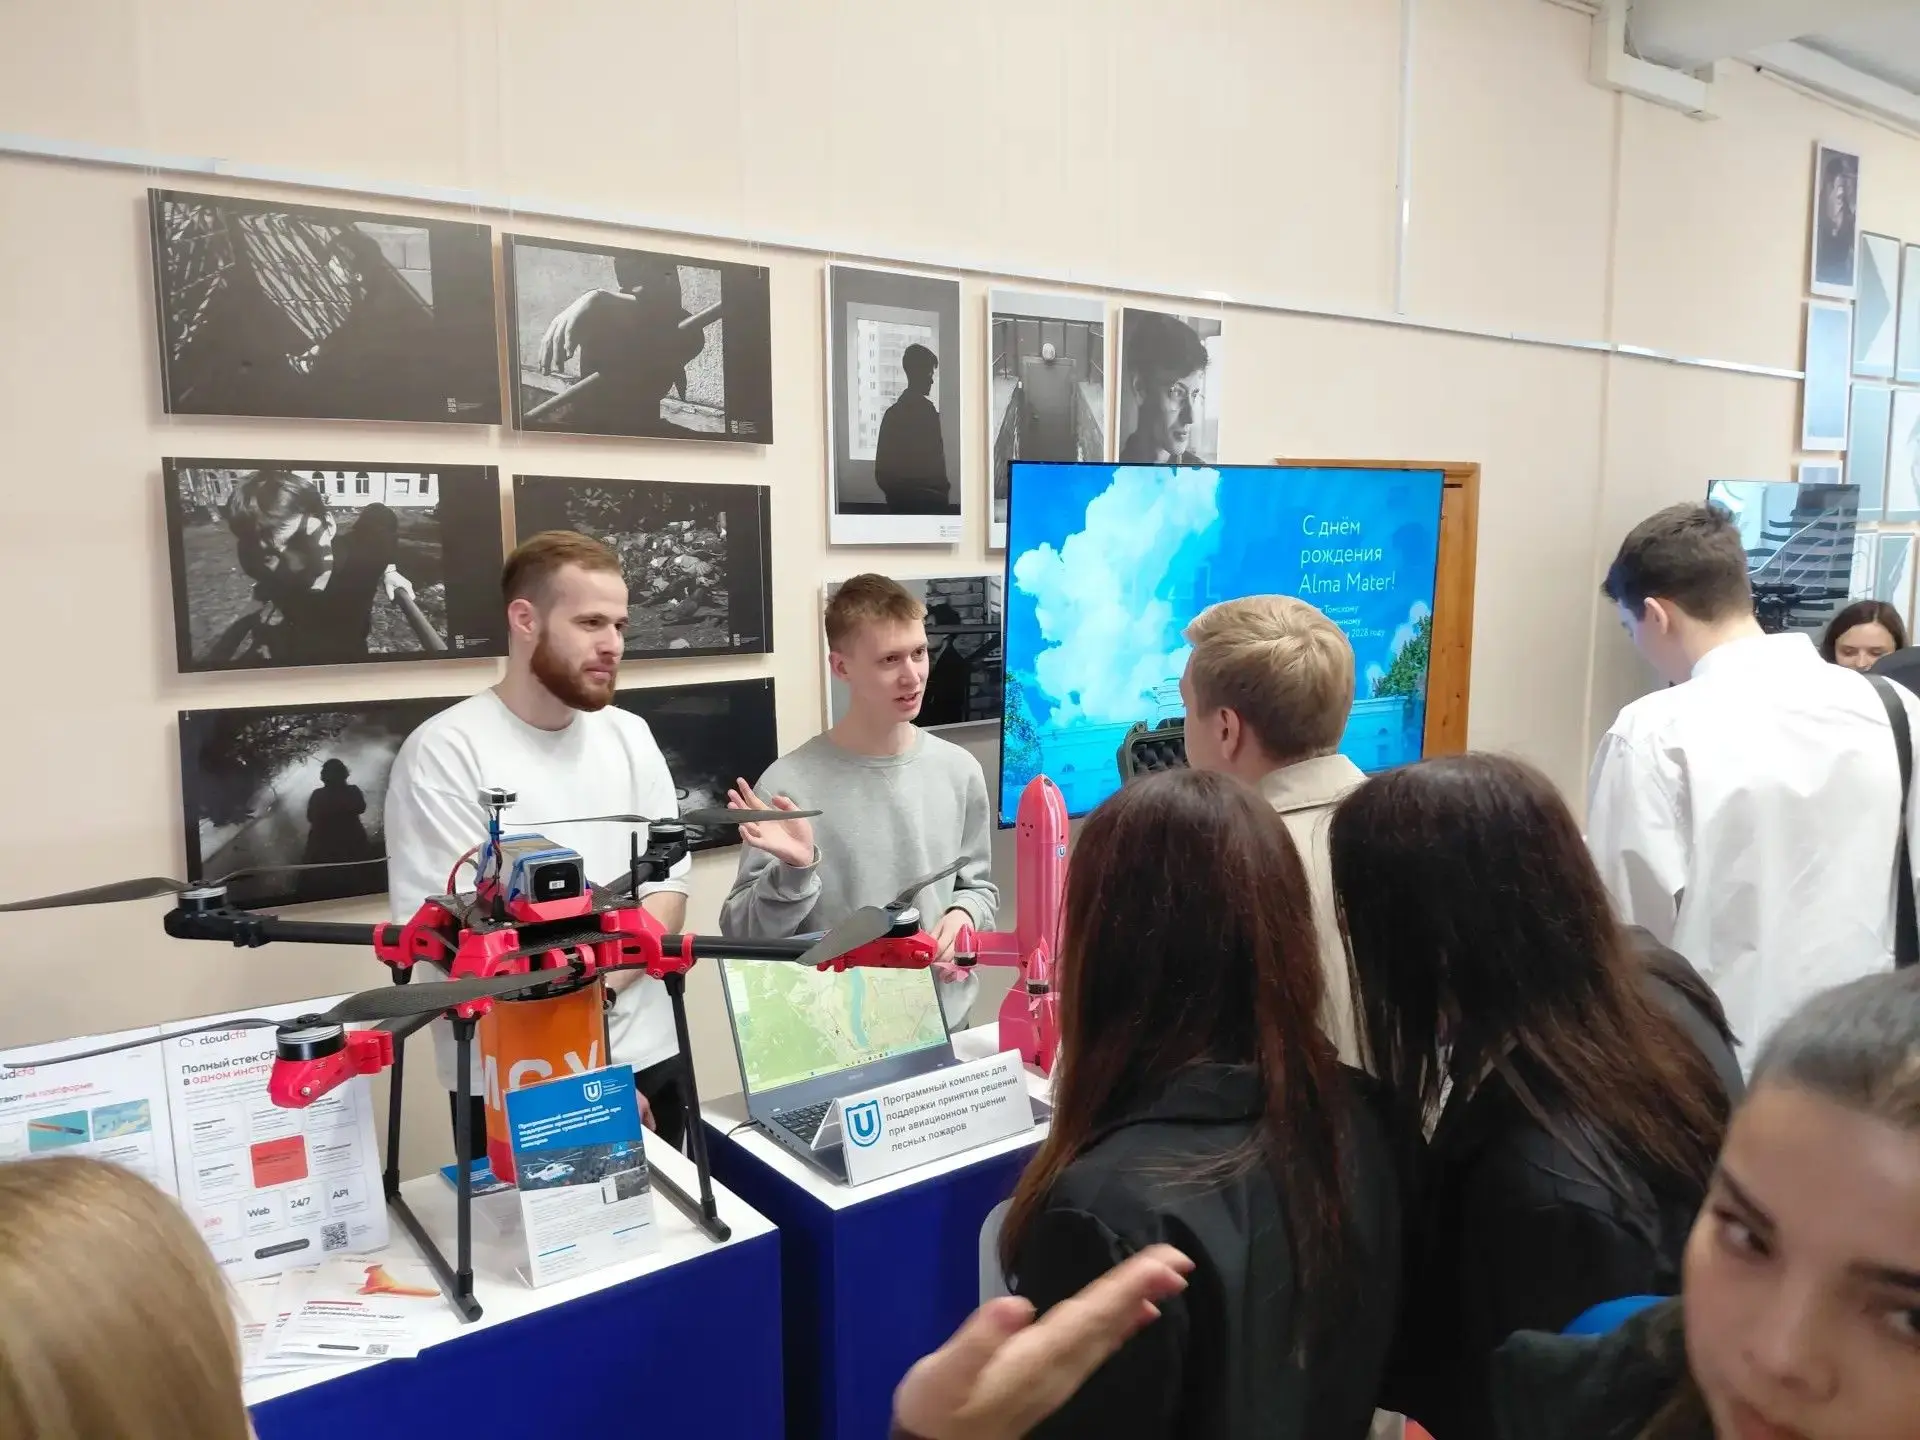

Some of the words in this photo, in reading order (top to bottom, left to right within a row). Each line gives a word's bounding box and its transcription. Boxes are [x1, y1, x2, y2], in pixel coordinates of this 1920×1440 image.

[1302, 514, 1316, 536] С
[1318, 515, 1361, 538] днём
[1300, 548, 1383, 568] рождения
[1299, 573, 1341, 594] Alma
[1346, 570, 1396, 592] Mater!
[199, 1029, 248, 1046] cloudcfd
[181, 1056, 231, 1075] Полный
[232, 1054, 260, 1067] стек
[183, 1078, 191, 1086] в
[192, 1071, 232, 1086] одном
[883, 1081, 948, 1107] Программный
[949, 1069, 990, 1088] комплекс
[991, 1063, 1008, 1077] для
[886, 1100, 936, 1121] поддержки
[938, 1089, 980, 1107] принятия
[981, 1076, 1018, 1096] решений
[888, 1124, 907, 1138] при
[908, 1107, 969, 1131] авиационном
[970, 1094, 1007, 1114] тушении
[891, 1135, 927, 1152] лесных
[928, 1122, 968, 1142] пожаров
[290, 1196, 311, 1209] 24/7
[332, 1188, 349, 1200] API
[247, 1206, 271, 1218] Web
